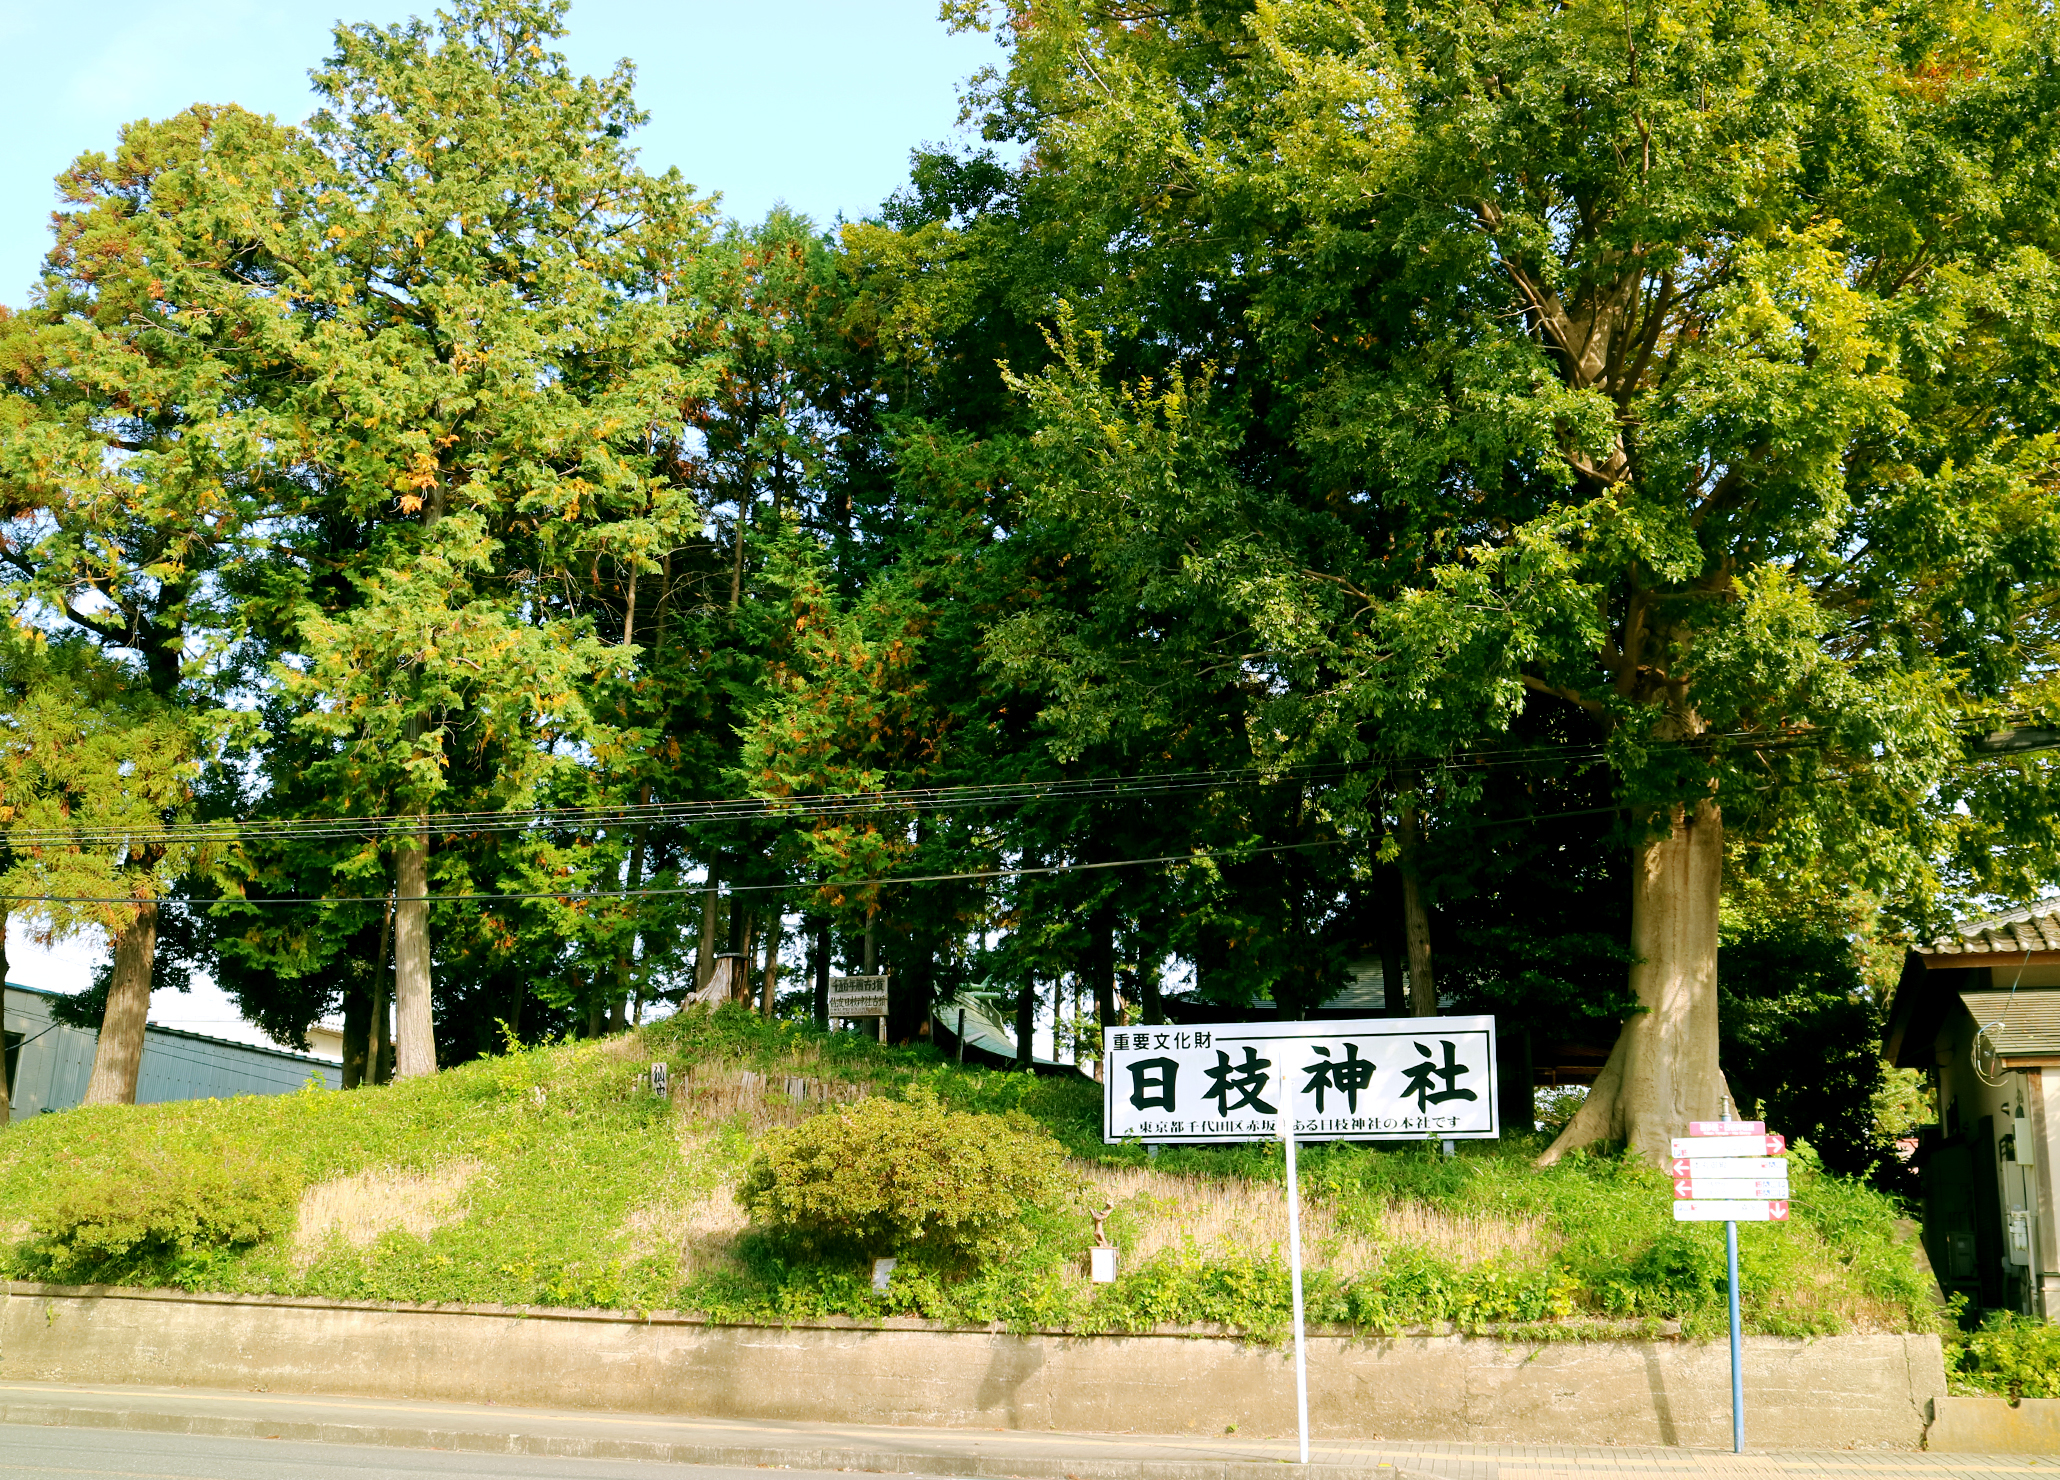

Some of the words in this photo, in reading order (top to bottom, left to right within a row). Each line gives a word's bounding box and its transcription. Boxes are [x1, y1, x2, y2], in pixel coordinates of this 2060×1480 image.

[1112, 1031, 1212, 1051] 重要文化財
[1126, 1040, 1478, 1118] 日枝神社
[1139, 1115, 1461, 1134] 東京都千代田区赤坂ある日枝神社の本社です
